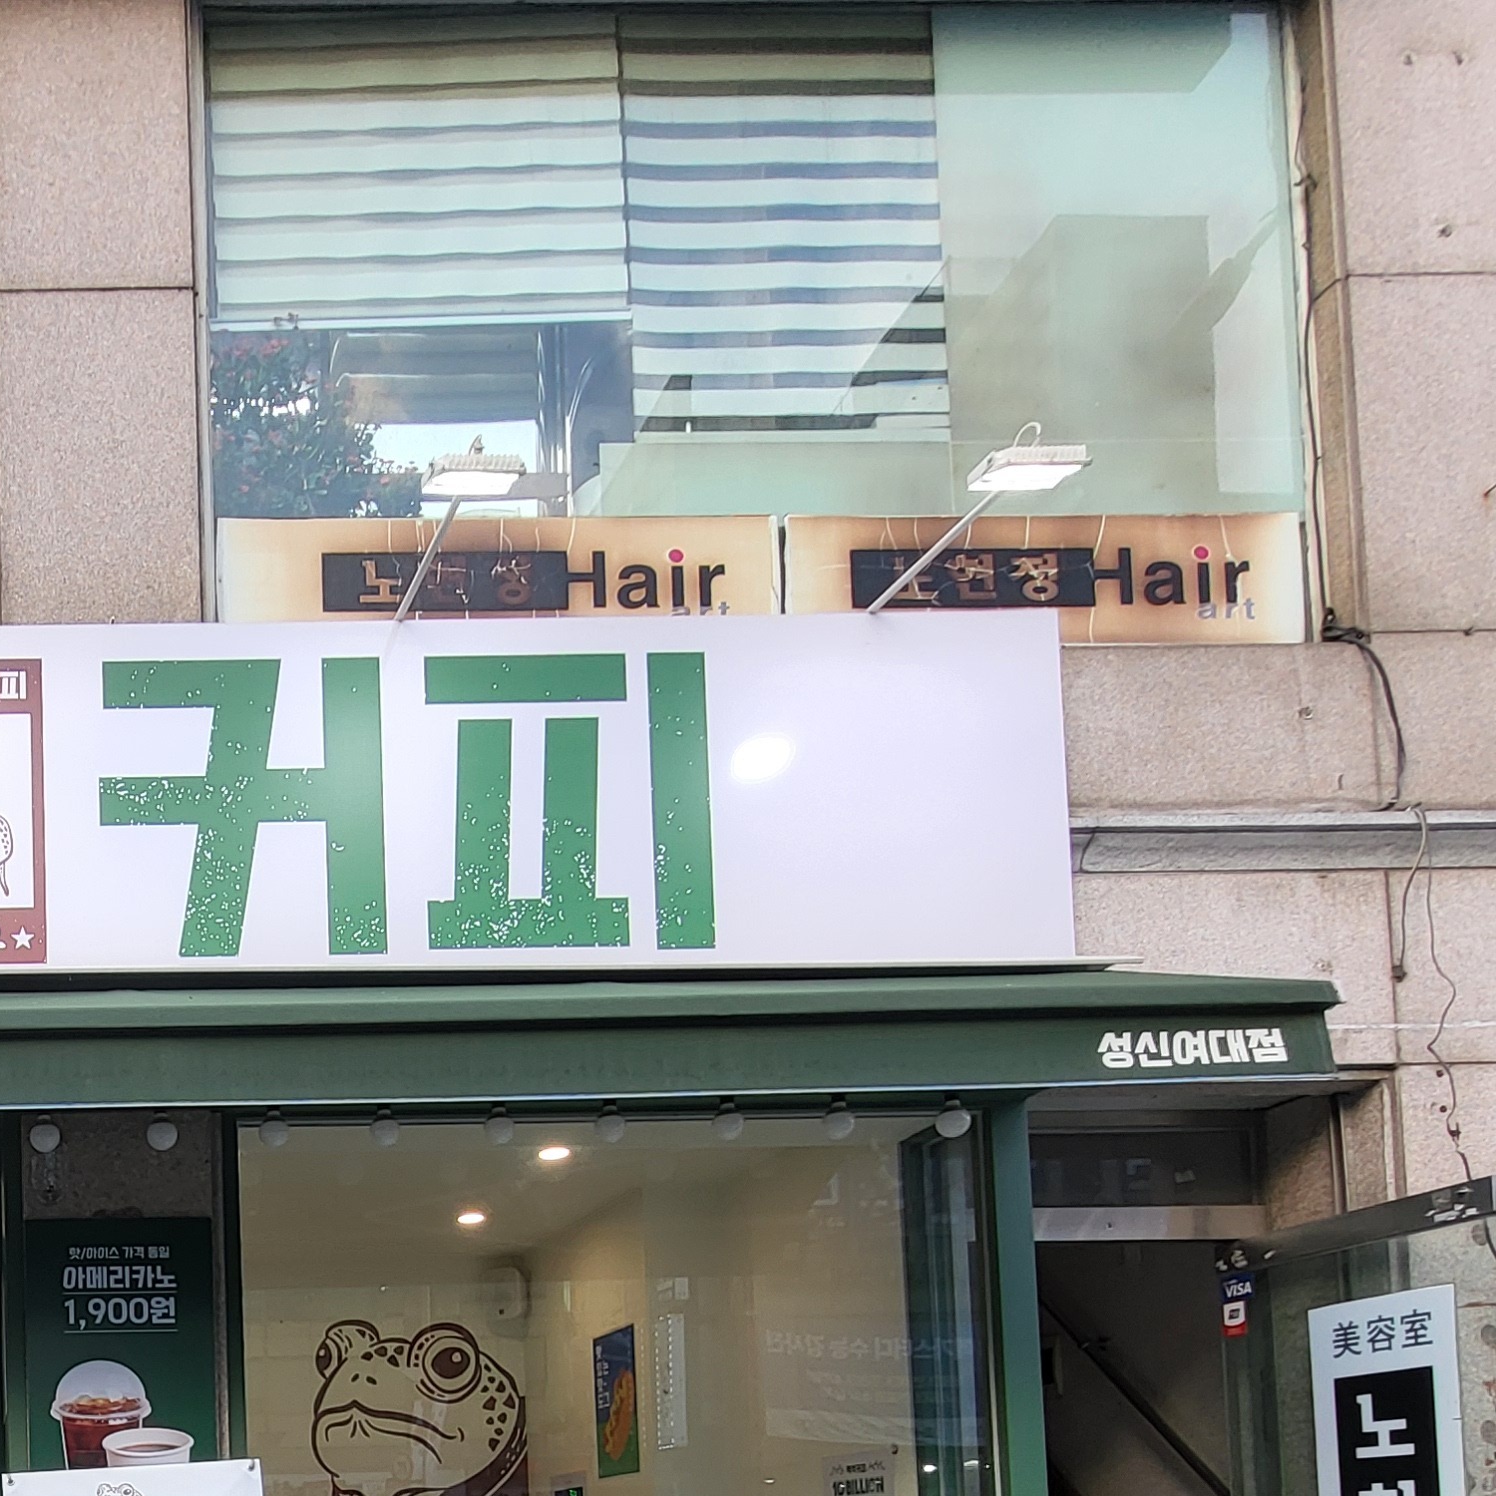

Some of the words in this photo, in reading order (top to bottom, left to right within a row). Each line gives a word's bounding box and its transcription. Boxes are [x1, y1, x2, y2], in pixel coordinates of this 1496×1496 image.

[556, 549, 725, 608] Hair
[1082, 545, 1250, 606] Hair
[1197, 598, 1256, 620] art
[99, 652, 716, 957] 커피
[1097, 1028, 1289, 1069] 성신여대점
[122, 1246, 145, 1259] 가격
[147, 1246, 170, 1259] 동일
[62, 1265, 178, 1290] 아메리카노
[1224, 1281, 1252, 1298] VISA
[64, 1296, 176, 1330] 1,900원
[1332, 1308, 1434, 1359] 美容室
[846, 1476, 884, 1496] BILLION
